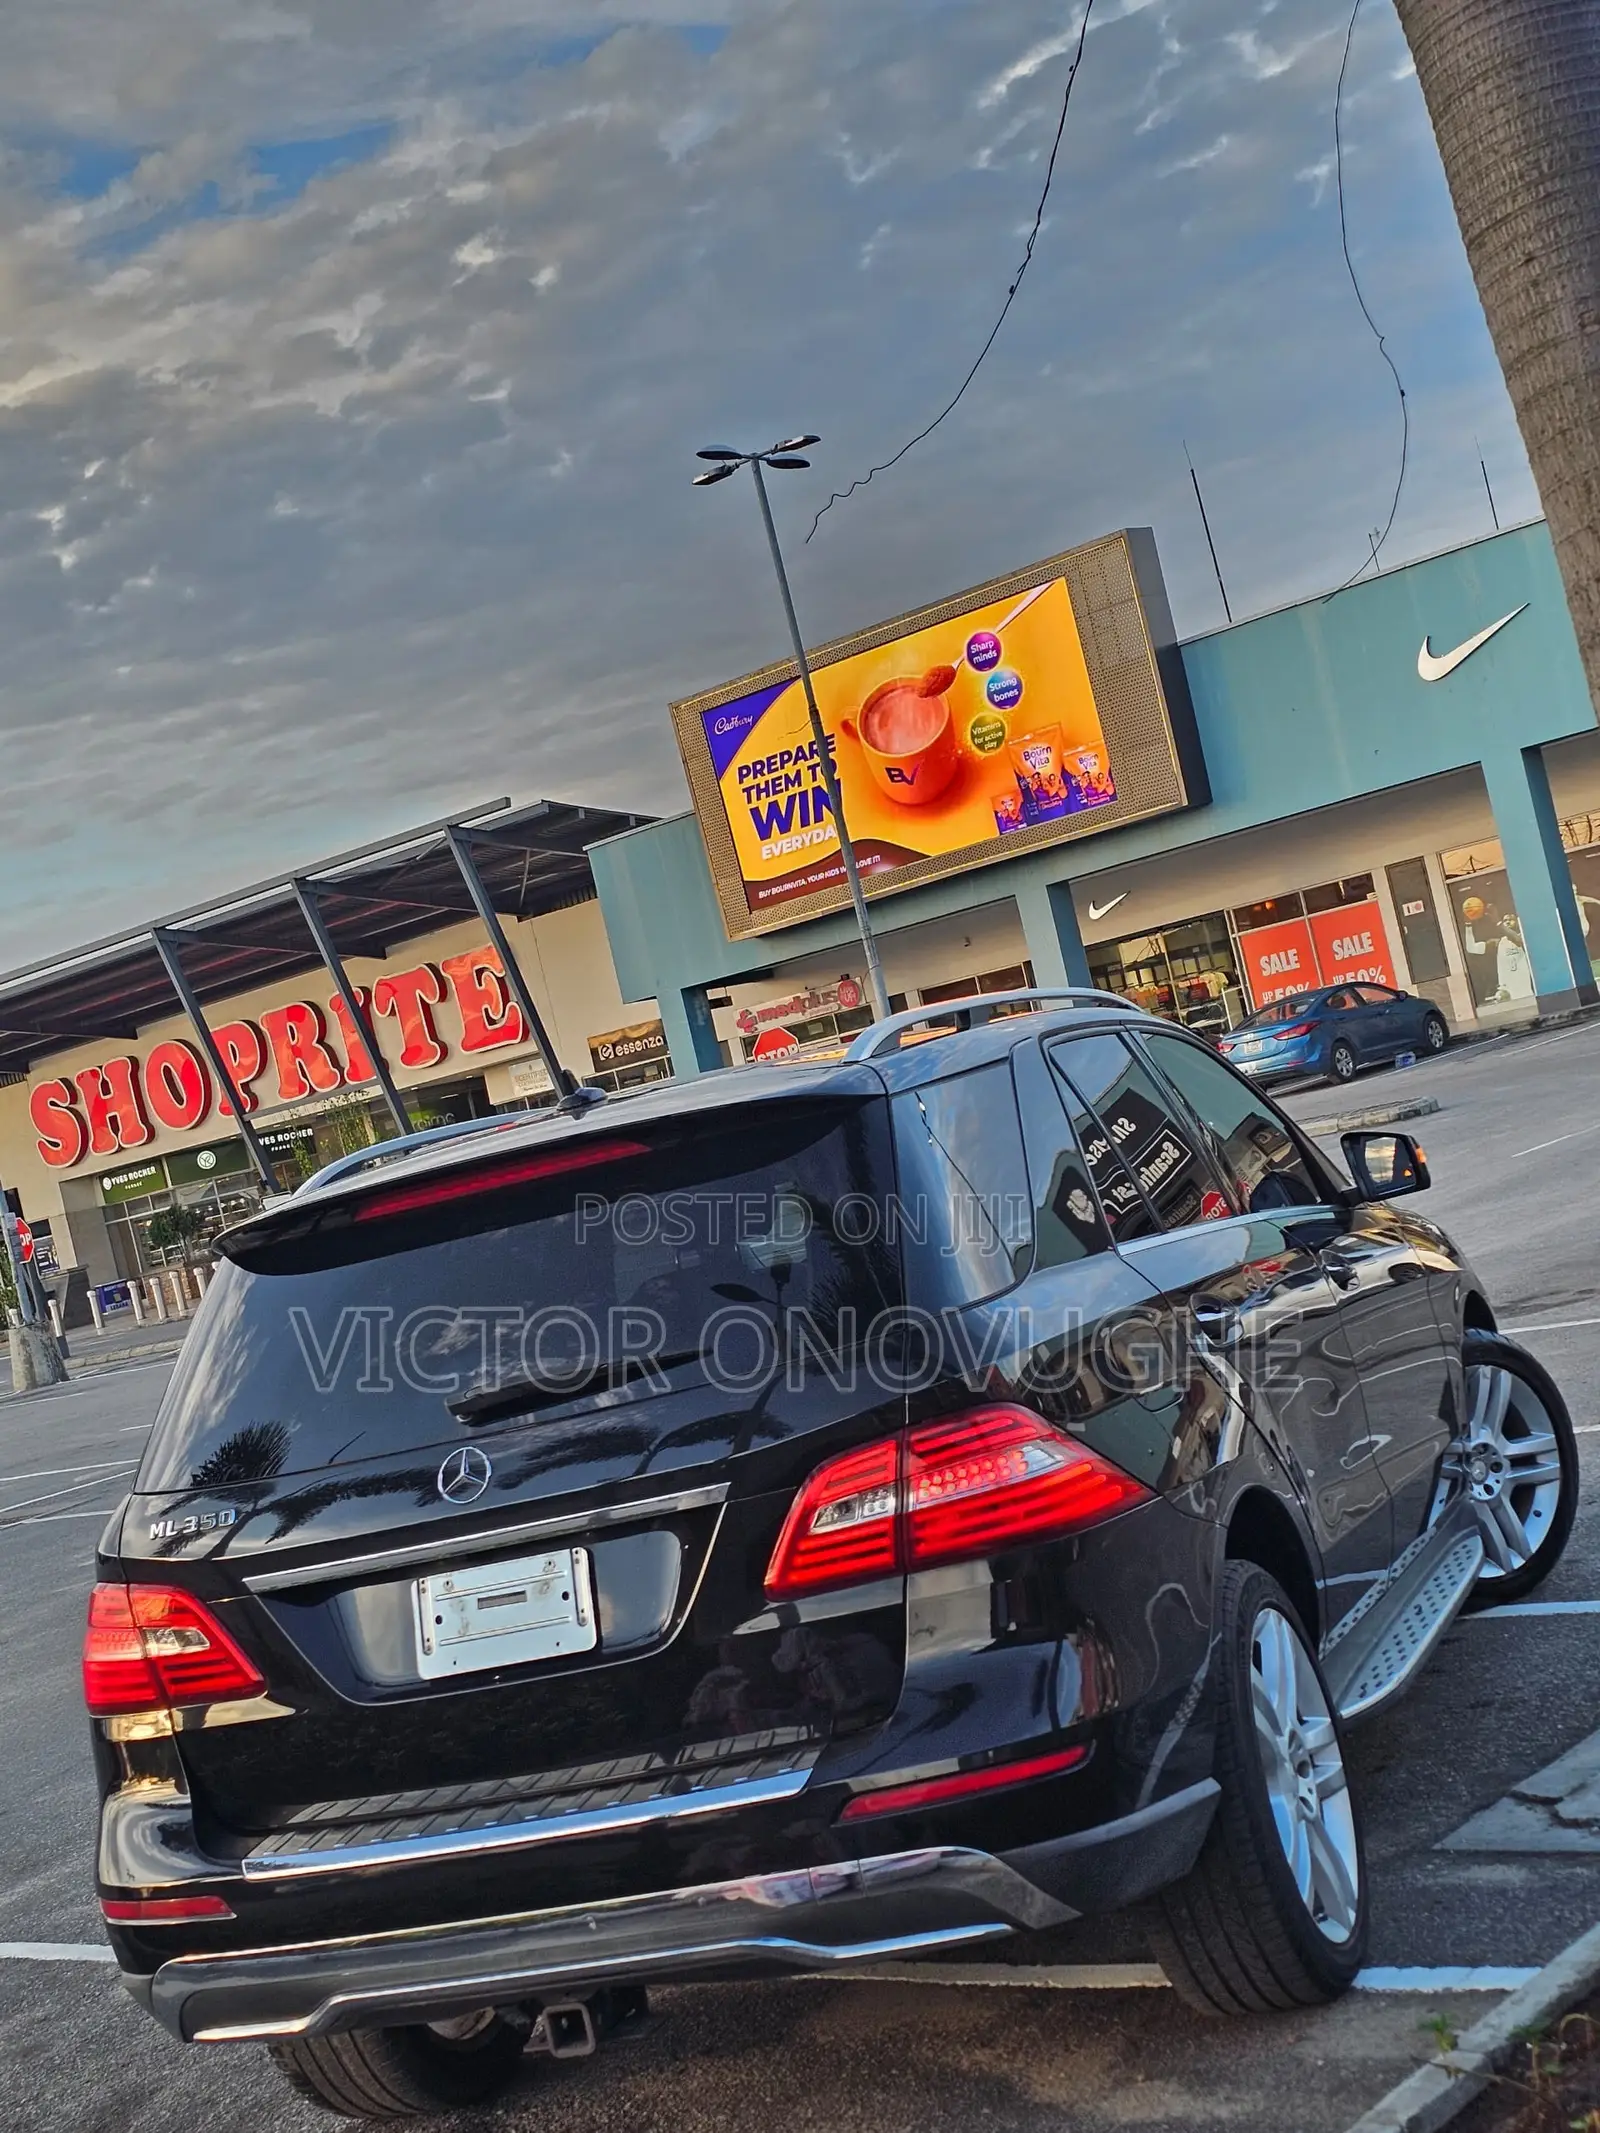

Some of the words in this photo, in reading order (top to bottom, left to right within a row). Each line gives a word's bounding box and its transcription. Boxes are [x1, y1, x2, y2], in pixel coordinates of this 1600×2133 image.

[970, 640, 995, 654] Sharp
[973, 649, 998, 665] minds
[988, 677, 1018, 692] Strong
[993, 688, 1019, 703] bones
[714, 715, 753, 735] Cadbury
[974, 736, 984, 745] for
[984, 731, 1003, 742] active
[984, 741, 998, 751] play
[1023, 746, 1052, 761] Bourn
[1029, 757, 1050, 769] Vita
[742, 768, 802, 805] THEM
[749, 778, 842, 841] WIN
[761, 826, 838, 860] EVERYDA
[758, 888, 772, 899] BUY
[807, 870, 825, 883] YOUR
[825, 867, 840, 879] KIDS
[855, 857, 873, 869] LOVE
[1332, 931, 1375, 960] SALE
[1259, 949, 1300, 976] SALE
[1333, 974, 1345, 985] UP
[1262, 990, 1273, 1001] UP
[615, 1035, 664, 1057] essenza
[258, 1135, 276, 1146] VES
[111, 1174, 129, 1186] YVES
[128, 1166, 157, 1180] ROCHER
[149, 1520, 179, 1540] ML
[182, 1508, 237, 1534] 350
